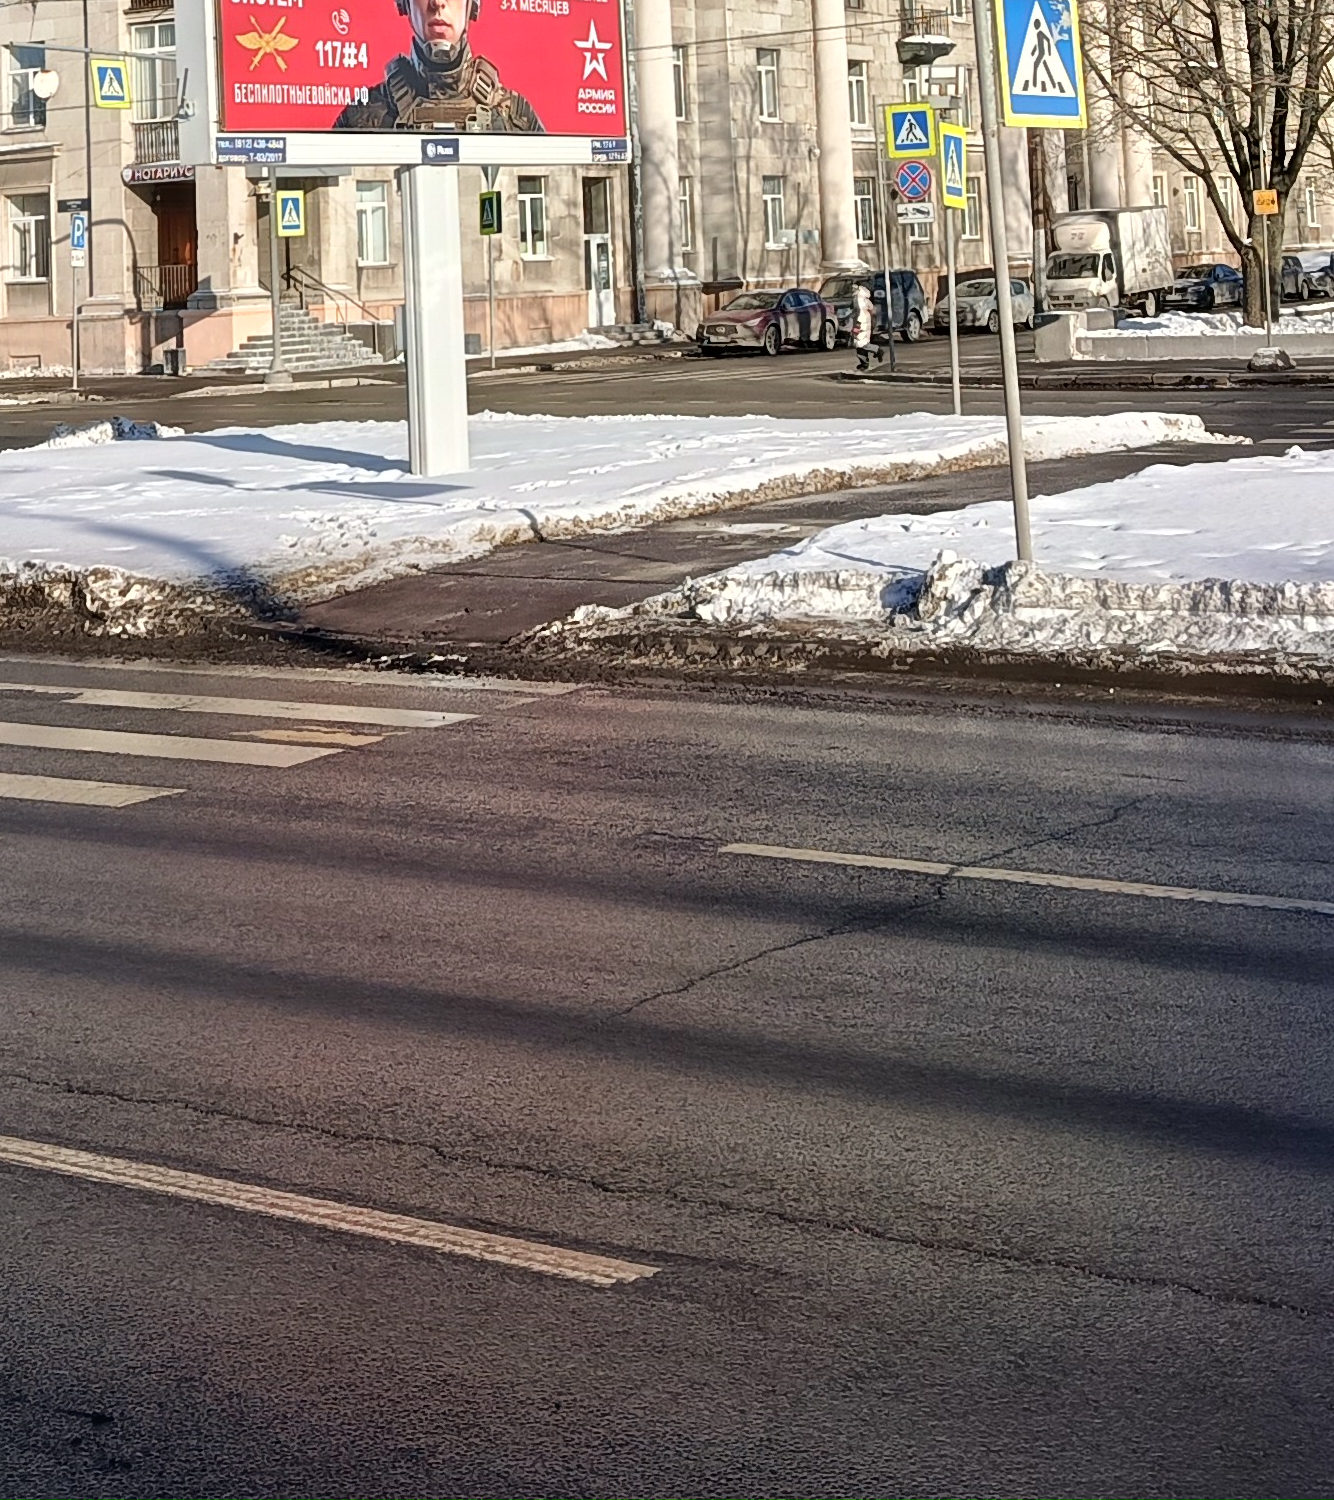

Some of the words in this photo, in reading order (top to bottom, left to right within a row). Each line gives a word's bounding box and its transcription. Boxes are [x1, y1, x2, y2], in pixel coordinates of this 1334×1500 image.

[315, 40, 368, 68] 117#4
[234, 82, 369, 106] БЕСПИЛОТНЫЕВОЙСКА.РФ
[578, 88, 615, 100] АРМИЯ
[578, 102, 616, 114] РОССИИ
[134, 165, 194, 180] НОТАРИУС
